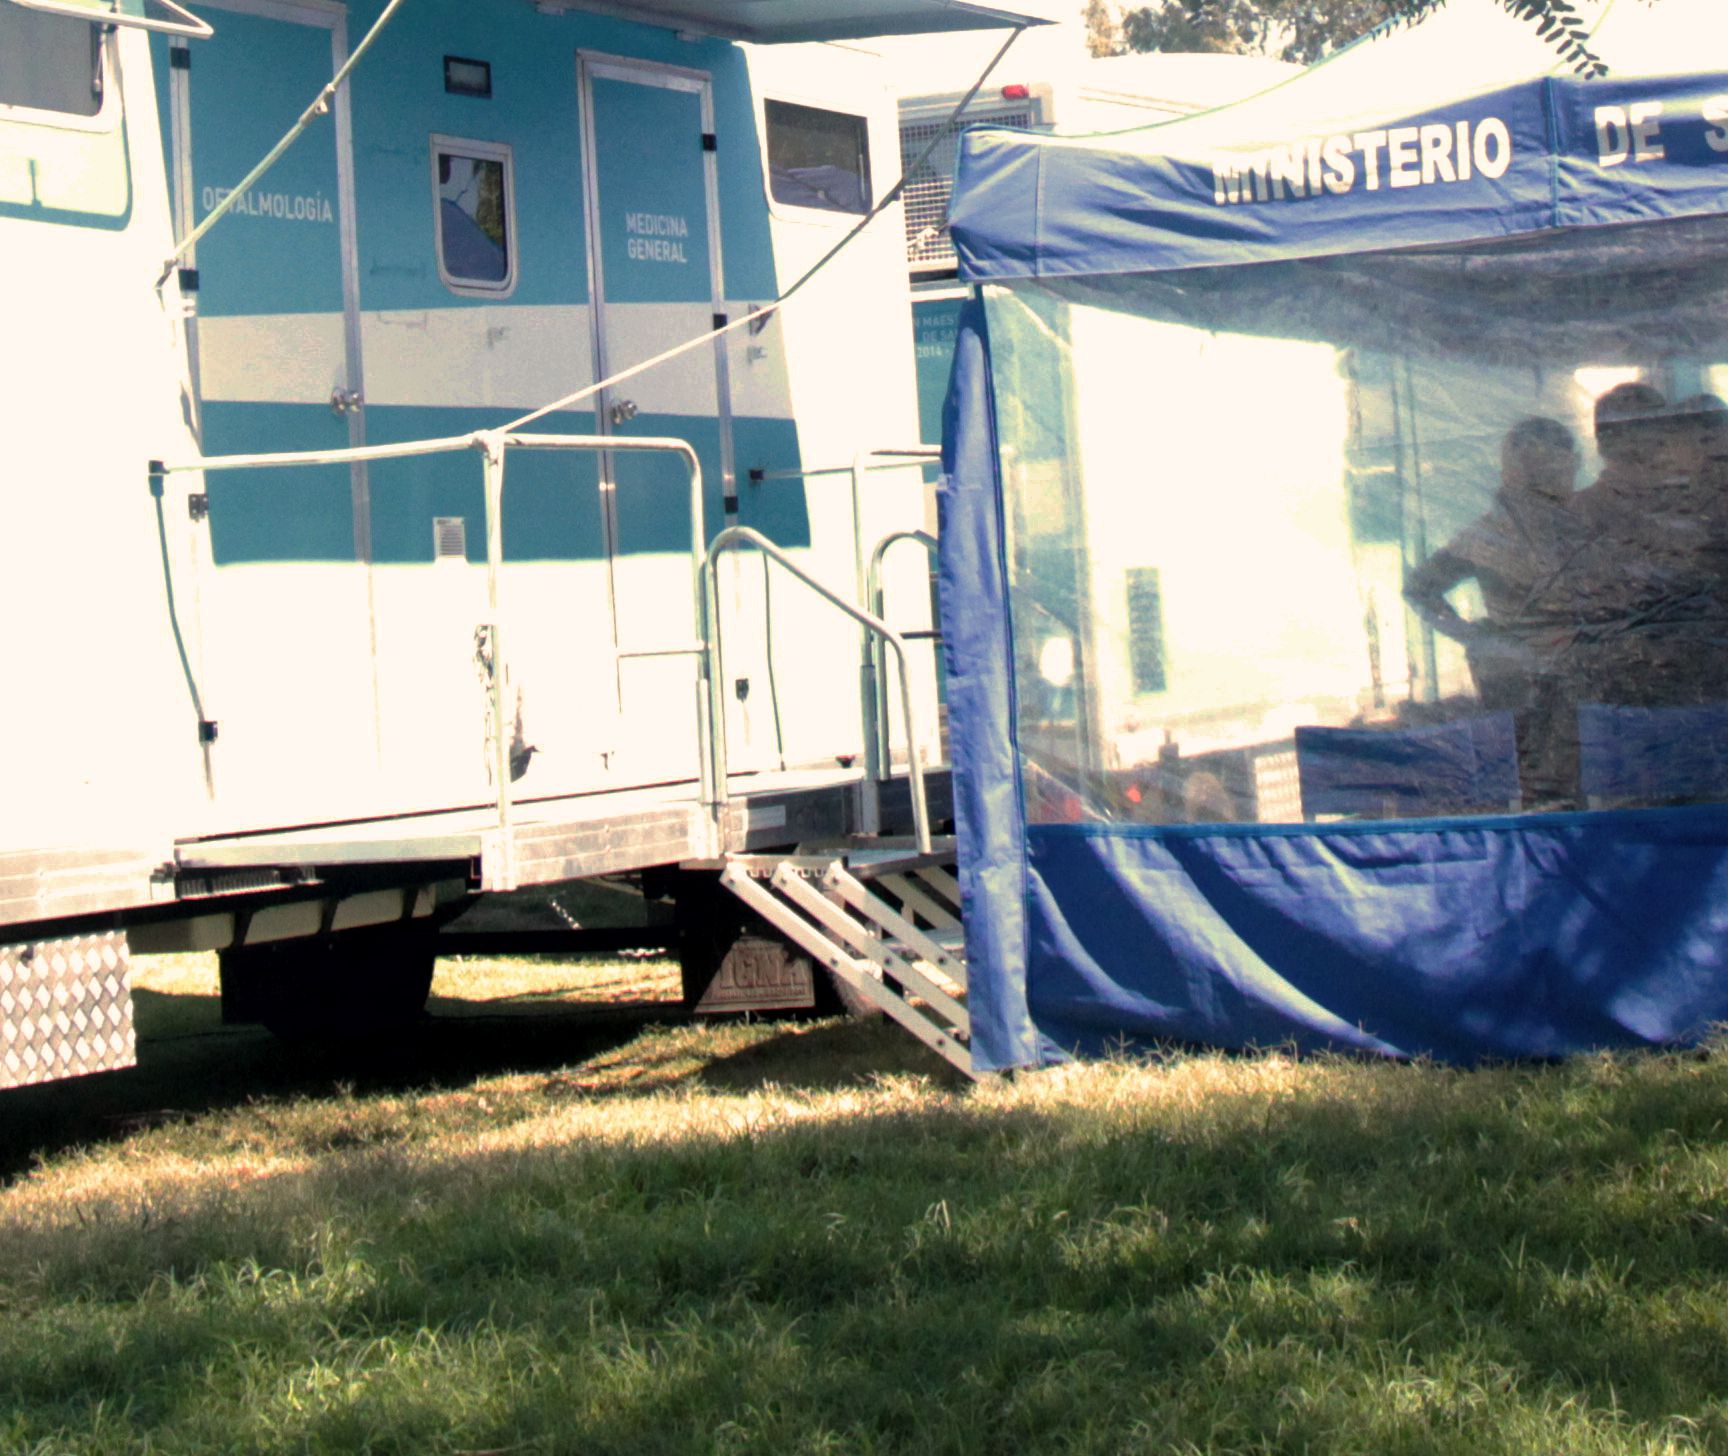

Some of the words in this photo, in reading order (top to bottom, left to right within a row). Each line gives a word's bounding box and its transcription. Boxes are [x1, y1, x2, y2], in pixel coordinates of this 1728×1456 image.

[1212, 117, 1511, 205] MINISTERIO
[1594, 101, 1664, 167] DE
[625, 211, 688, 237] MEDICINA
[627, 238, 687, 263] GENERAL
[720, 946, 808, 989] IGNA
